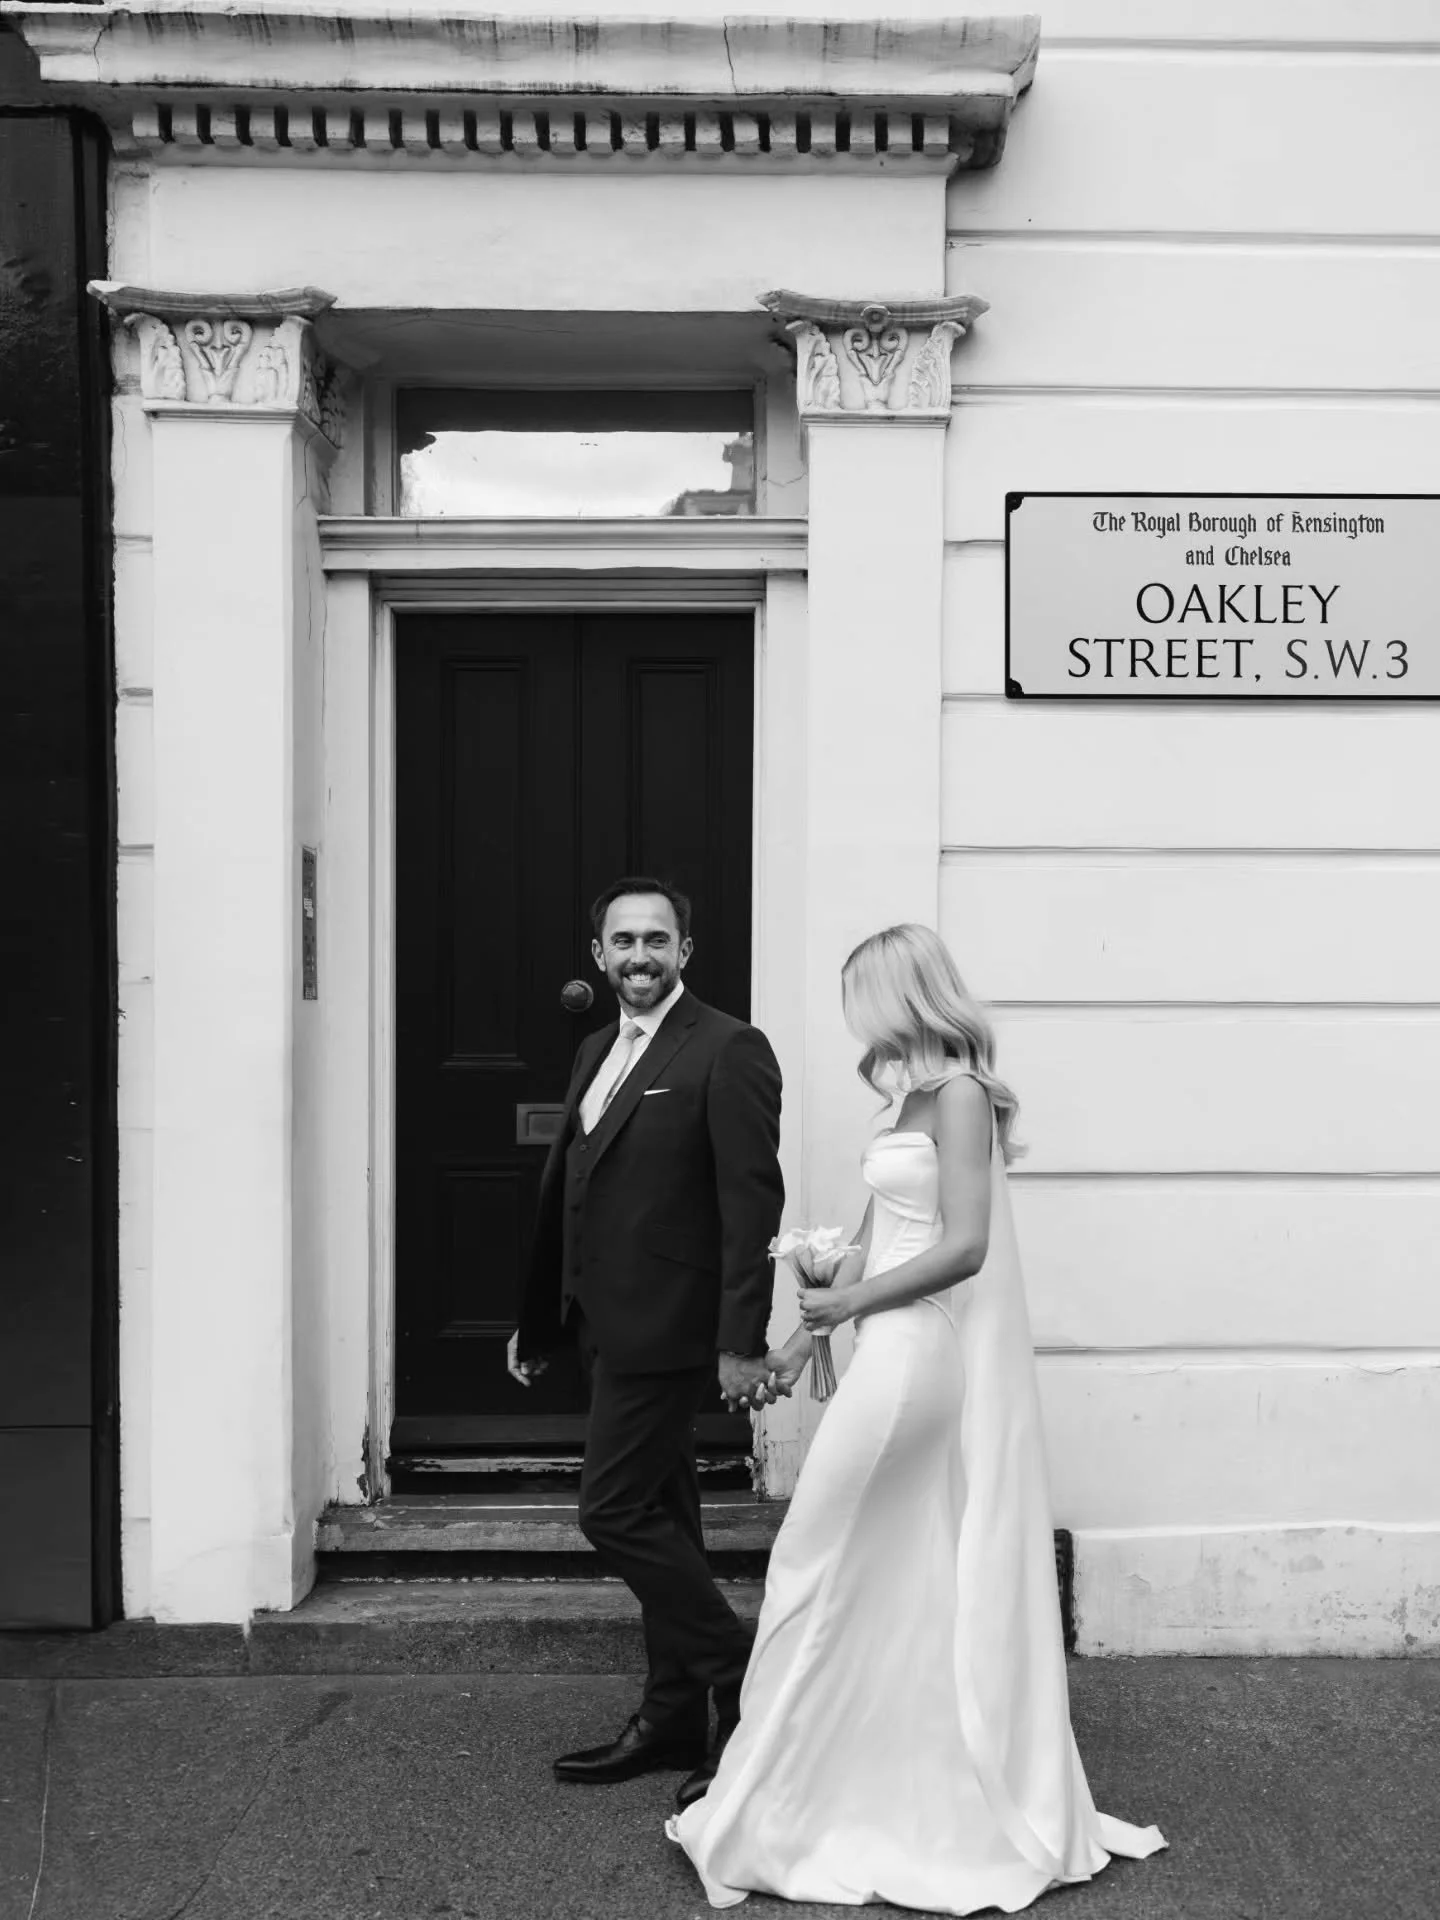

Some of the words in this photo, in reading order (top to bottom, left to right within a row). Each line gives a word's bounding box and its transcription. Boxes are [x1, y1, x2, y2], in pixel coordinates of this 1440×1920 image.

[1092, 511, 1127, 533] The
[1130, 511, 1181, 539] Royal
[1188, 511, 1257, 540] Borough
[1266, 512, 1285, 533] of
[1291, 511, 1385, 540] Kensington
[1185, 544, 1215, 566] and
[1224, 545, 1292, 567] Chelsea
[1136, 582, 1341, 625] OAKLEY
[1067, 637, 1261, 683] STREET,
[1284, 638, 1409, 680] S.W.3
